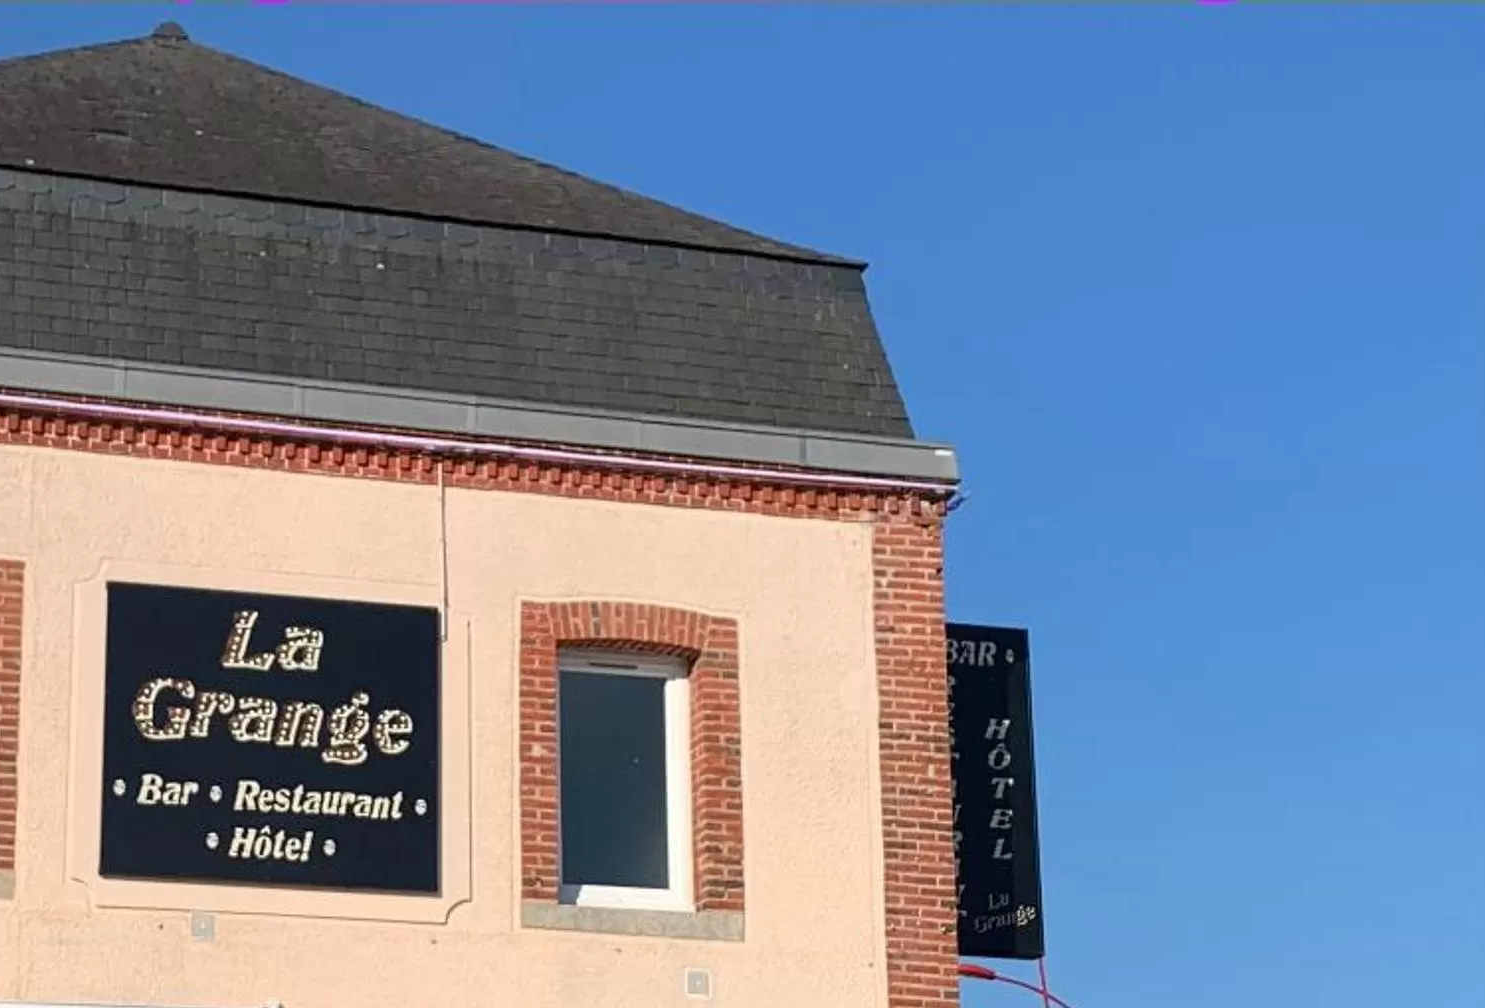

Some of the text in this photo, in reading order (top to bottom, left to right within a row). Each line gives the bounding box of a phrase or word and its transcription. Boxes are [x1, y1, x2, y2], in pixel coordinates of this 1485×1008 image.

[220, 610, 324, 671] La
[947, 638, 997, 666] BAR
[132, 677, 414, 765] Grange
[136, 773, 404, 820] Bar Restaurant
[985, 717, 1015, 861] HÔTEL
[228, 825, 314, 862] Hôtel
